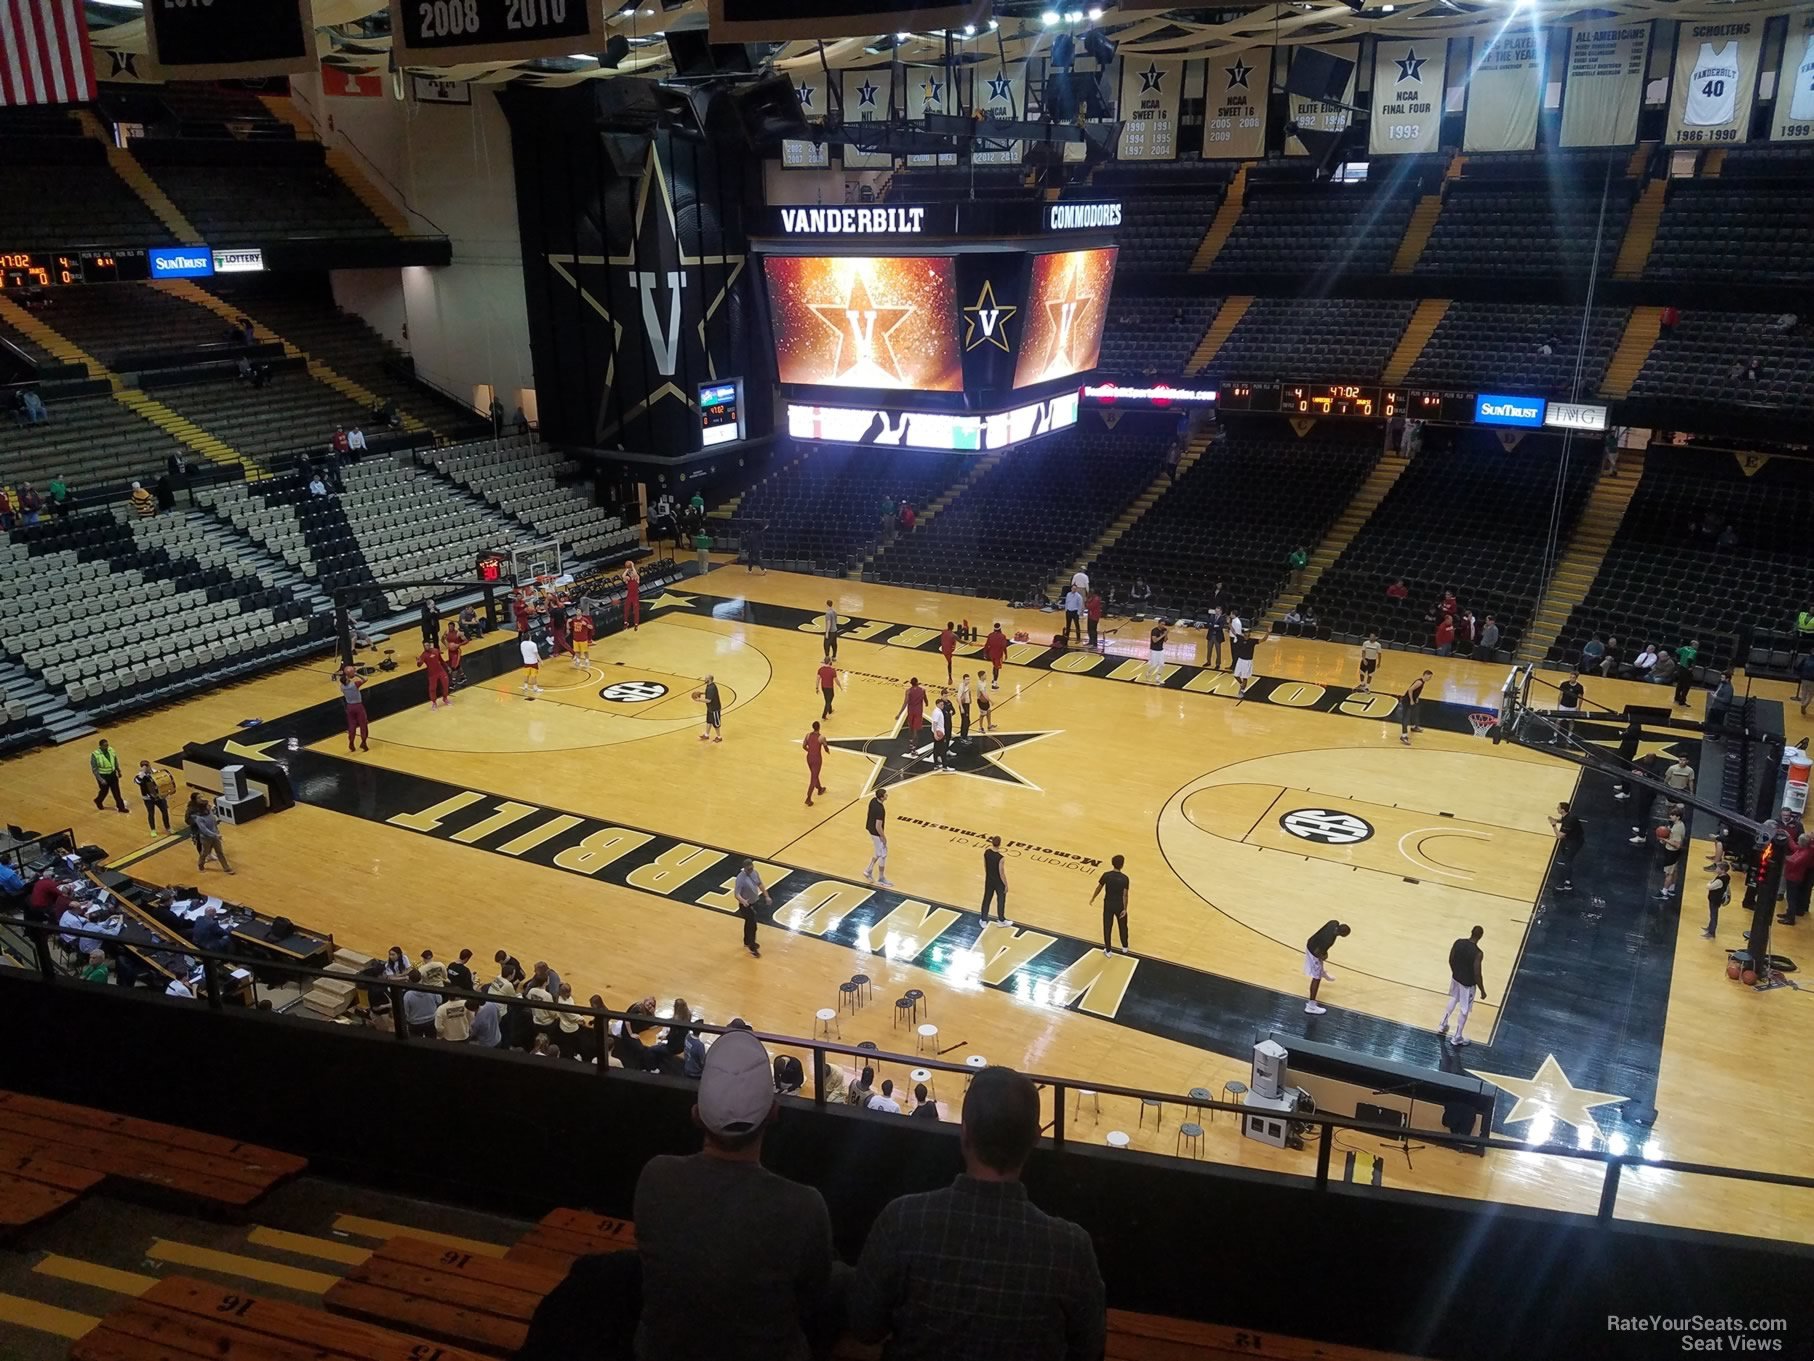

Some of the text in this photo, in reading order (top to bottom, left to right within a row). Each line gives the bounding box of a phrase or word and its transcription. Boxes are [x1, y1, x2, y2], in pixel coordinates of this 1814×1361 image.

[419, 2, 480, 38] 2008
[1692, 23, 1751, 37] SCHOLTENS
[1405, 60, 1416, 74] V
[1693, 68, 1737, 80] VANDERBILT
[1702, 80, 1725, 97] 40
[1227, 95, 1247, 106] NCAA
[1396, 91, 1418, 101] NCAA
[1141, 100, 1160, 109] NCAA
[1298, 104, 1318, 114] ELITE
[1382, 103, 1431, 115] FINAL FOUR
[1132, 111, 1154, 120] SWEET
[1218, 107, 1241, 117] SWEET
[1210, 119, 1231, 129] 2005
[1389, 125, 1419, 139] 1993
[781, 207, 924, 233] VANDERBILT
[1050, 203, 1122, 229] COMMODORES
[59, 256, 69, 268] 4
[225, 252, 260, 265] LOTTERY
[40, 273, 48, 285] 0
[62, 271, 70, 283] 0
[629, 271, 687, 376] V
[978, 310, 999, 337] V
[1295, 388, 1303, 398] 4
[1330, 386, 1360, 398] 47:02
[1387, 392, 1396, 403] 4
[1299, 401, 1308, 412] 0
[1322, 402, 1330, 413] 0
[1364, 404, 1372, 415] 0
[1386, 405, 1394, 416] 0
[1556, 407, 1596, 424] IMG
[1284, 810, 1370, 843] SEC
[1007, 840, 1103, 868] Memorial
[1030, 854, 1095, 875] Ingram
[386, 791, 1140, 1019] VANDERBILT
[597, 1219, 626, 1235] 16
[440, 1250, 473, 1269] 16
[216, 1294, 256, 1317] 16
